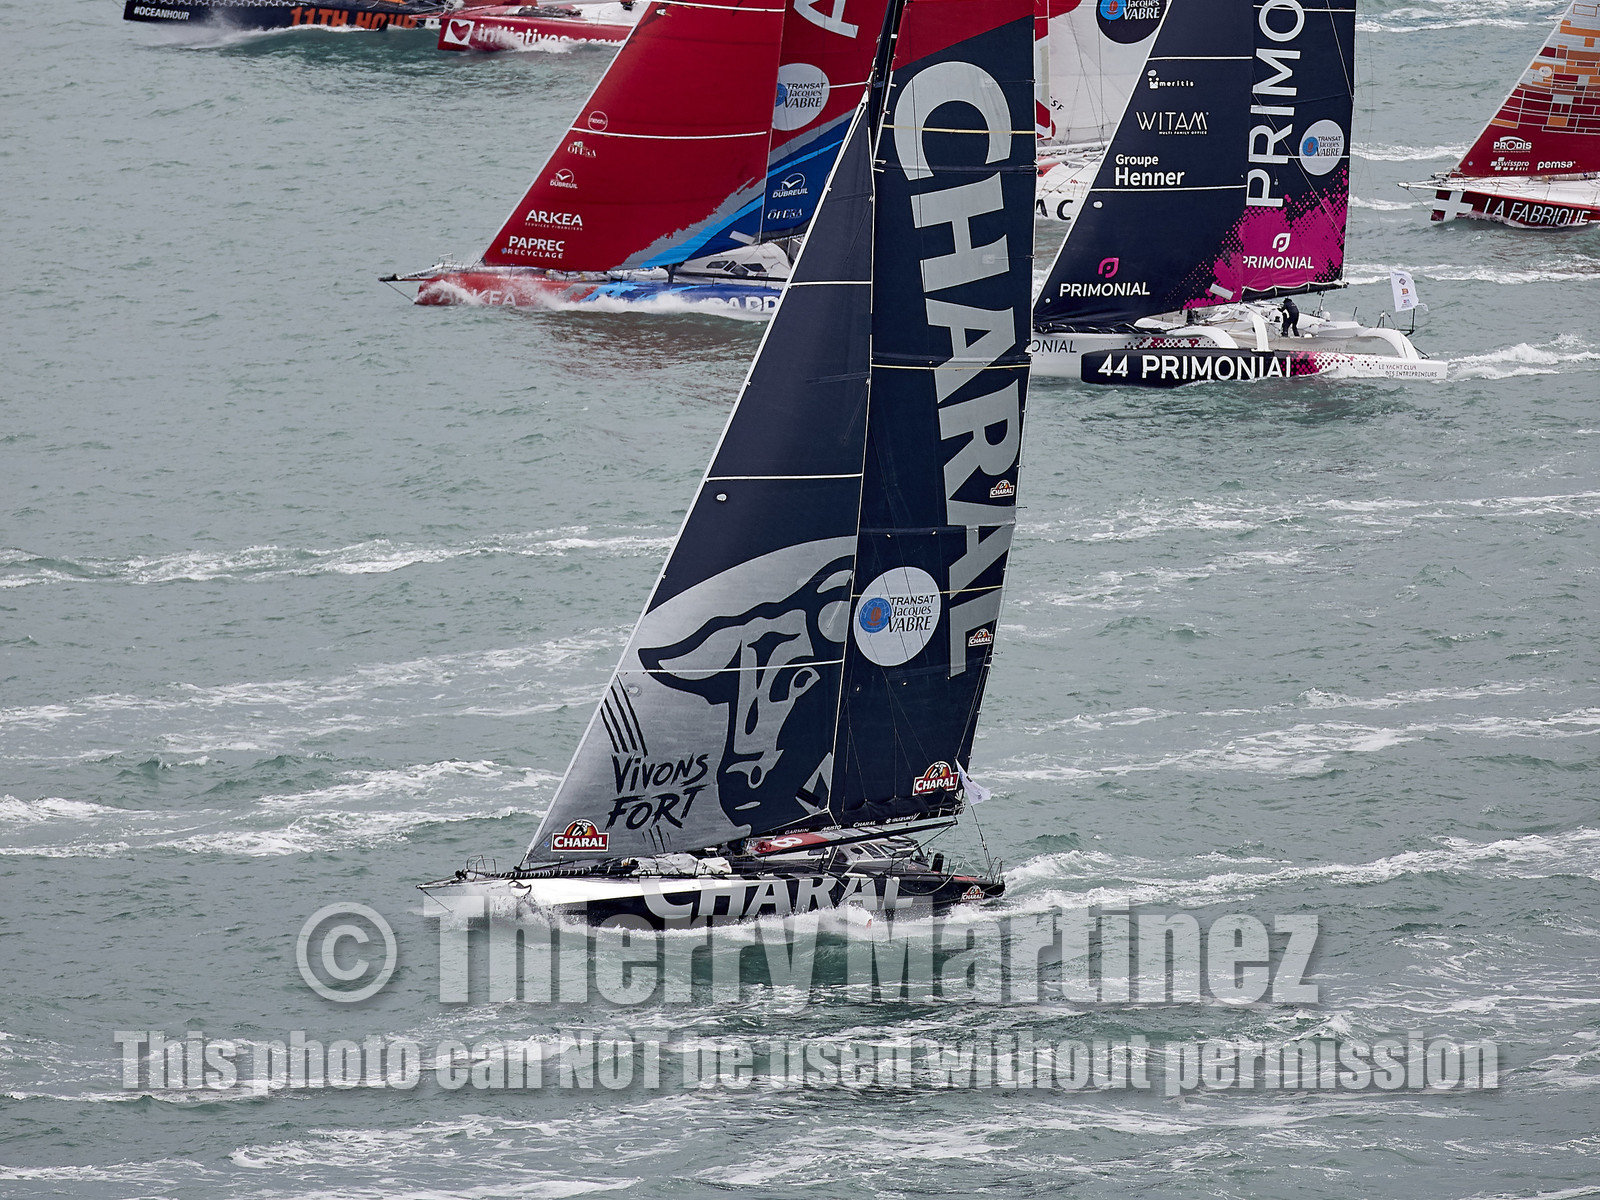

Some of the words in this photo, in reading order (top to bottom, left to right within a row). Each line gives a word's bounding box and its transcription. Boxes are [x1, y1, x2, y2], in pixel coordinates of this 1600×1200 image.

[133, 6, 190, 20] #OCEANHOUR
[1122, 7, 1160, 20] VABRE
[789, 89, 822, 98] Jacques
[784, 97, 822, 108] VABRE
[1136, 112, 1208, 131] WITAM
[1315, 147, 1340, 157] VABRE
[1493, 141, 1532, 150] PRODIS
[1115, 154, 1159, 168] Groupe
[1537, 161, 1574, 170] pemsa
[1115, 167, 1185, 186] Henner
[772, 187, 808, 198] DUBREUIL
[525, 209, 583, 226] ARKEA
[1484, 198, 1506, 216] LA
[1509, 202, 1590, 225] FABRIQUE
[509, 235, 565, 252] PAPREC
[507, 249, 563, 259] RECYCLAGE
[1243, 255, 1314, 270] PRIMONIAL
[1060, 282, 1150, 297] PRIMONIAL
[1032, 339, 1077, 353] ONIAL
[894, 61, 1020, 678] CHARAL
[1098, 353, 1128, 377] 44
[991, 488, 1013, 497] CHARAL
[891, 595, 935, 604] TRANSAT
[893, 605, 932, 617] Jacques
[888, 616, 931, 633] VABRE
[969, 636, 992, 646] CHARAL
[915, 776, 957, 794] CHARAL
[605, 785, 707, 829] FORT
[784, 827, 809, 835] GARMIN
[553, 836, 606, 848] CHARAL
[641, 875, 914, 919] CHARAL
